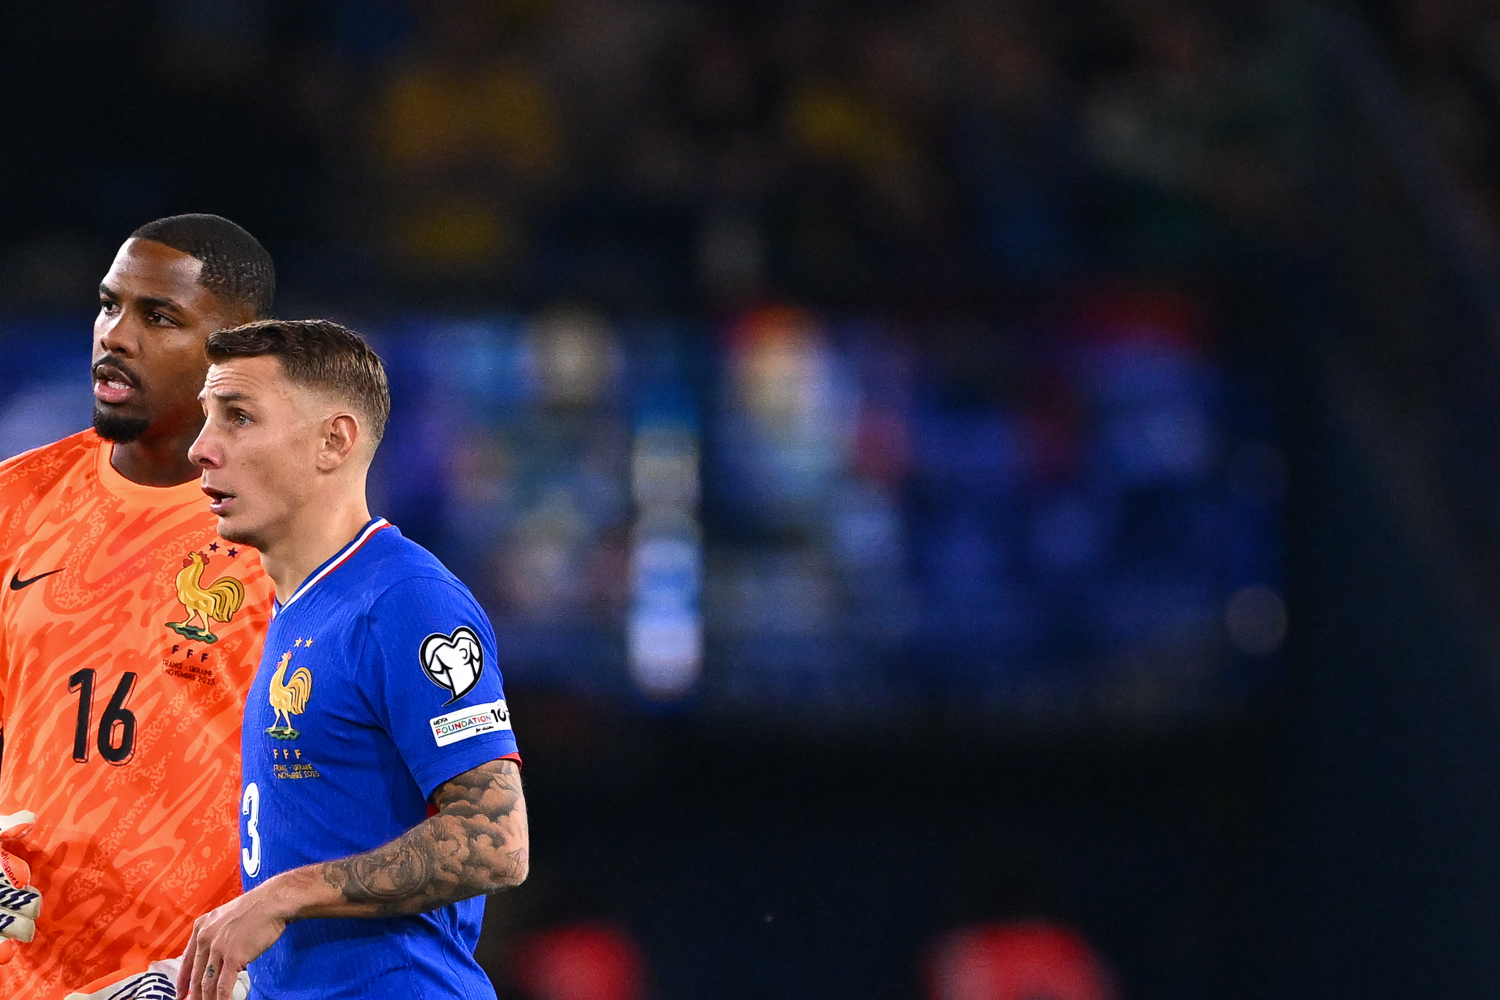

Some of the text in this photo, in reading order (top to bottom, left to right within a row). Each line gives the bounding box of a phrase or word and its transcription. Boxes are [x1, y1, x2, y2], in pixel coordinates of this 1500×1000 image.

[67, 668, 138, 767] 16
[435, 714, 492, 736] FOUNDATION
[242, 782, 261, 878] 3
